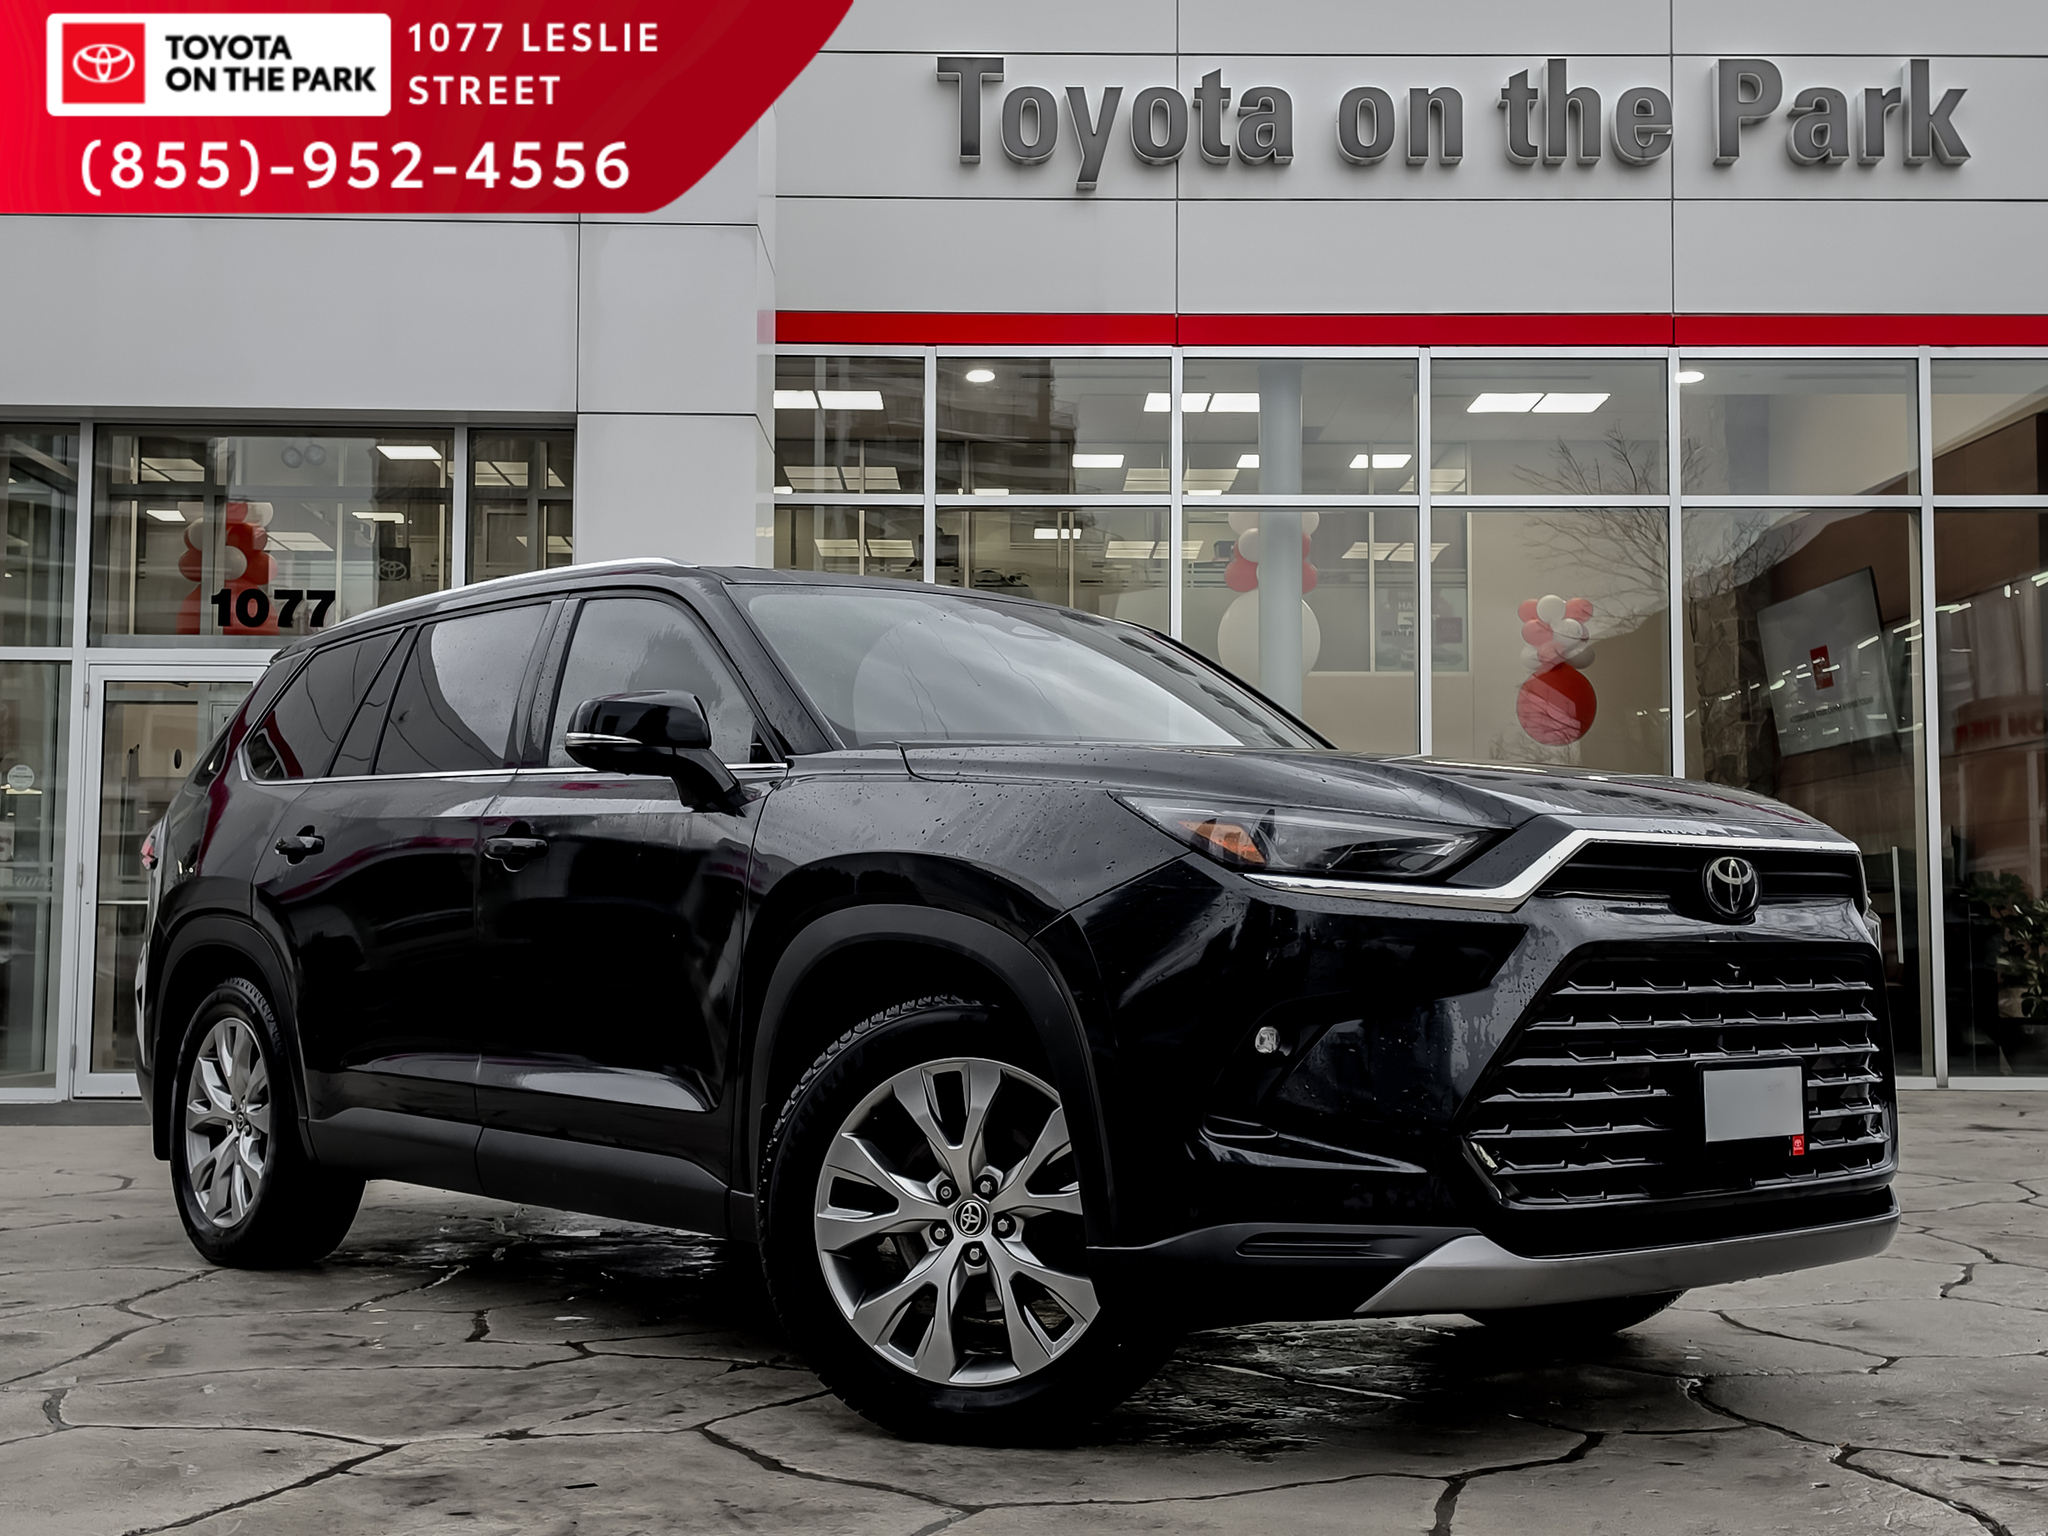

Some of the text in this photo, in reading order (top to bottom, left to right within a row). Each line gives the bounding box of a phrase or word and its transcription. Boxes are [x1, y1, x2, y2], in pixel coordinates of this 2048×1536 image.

[937, 57, 1971, 190] Toyota on the Park
[211, 588, 336, 628] 1077
